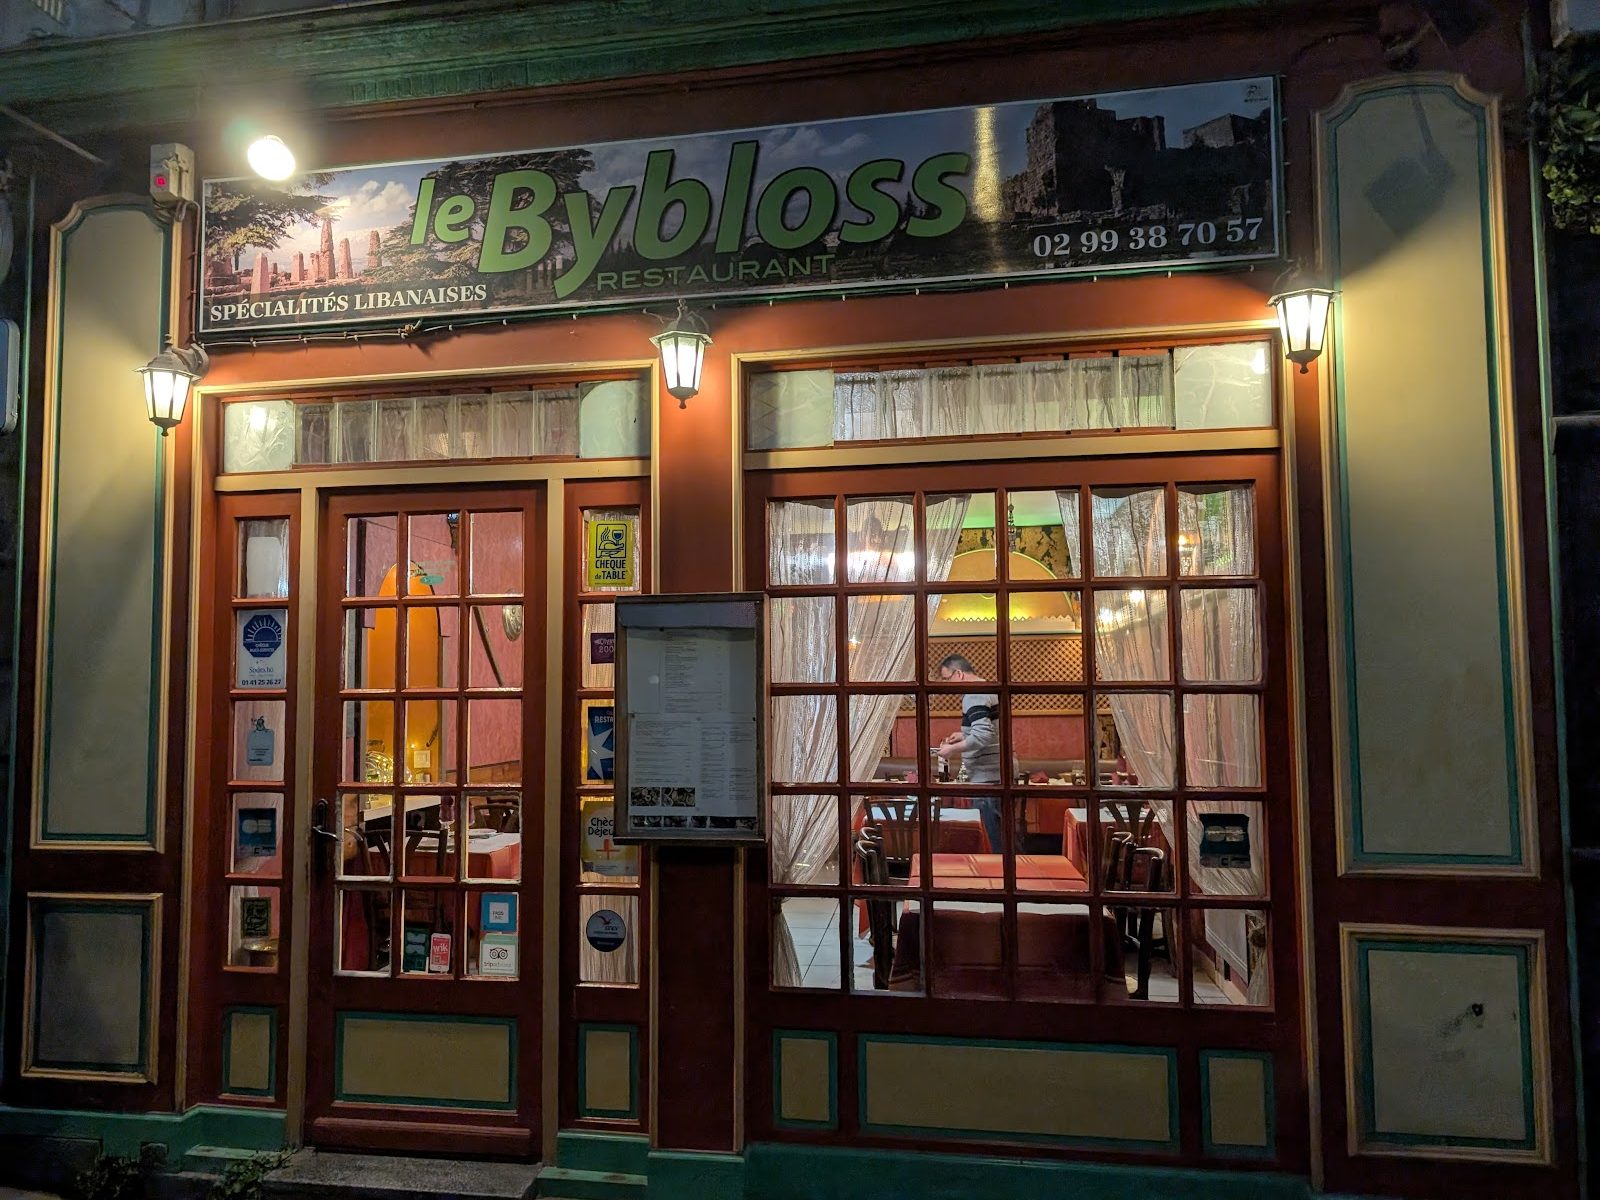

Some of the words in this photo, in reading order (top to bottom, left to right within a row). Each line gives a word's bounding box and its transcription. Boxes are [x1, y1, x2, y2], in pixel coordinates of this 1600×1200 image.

[477, 139, 973, 298] Bybloss
[1033, 233, 1071, 257] 02
[1081, 230, 1119, 255] 99
[1128, 226, 1168, 250] 38
[1178, 221, 1217, 247] 70
[1226, 217, 1264, 243] 57
[597, 253, 836, 292] RESTAURANT
[210, 290, 349, 323] SPÉCIALITÉS
[354, 283, 488, 311] LIBANAISES
[601, 570, 626, 580] TABLE
